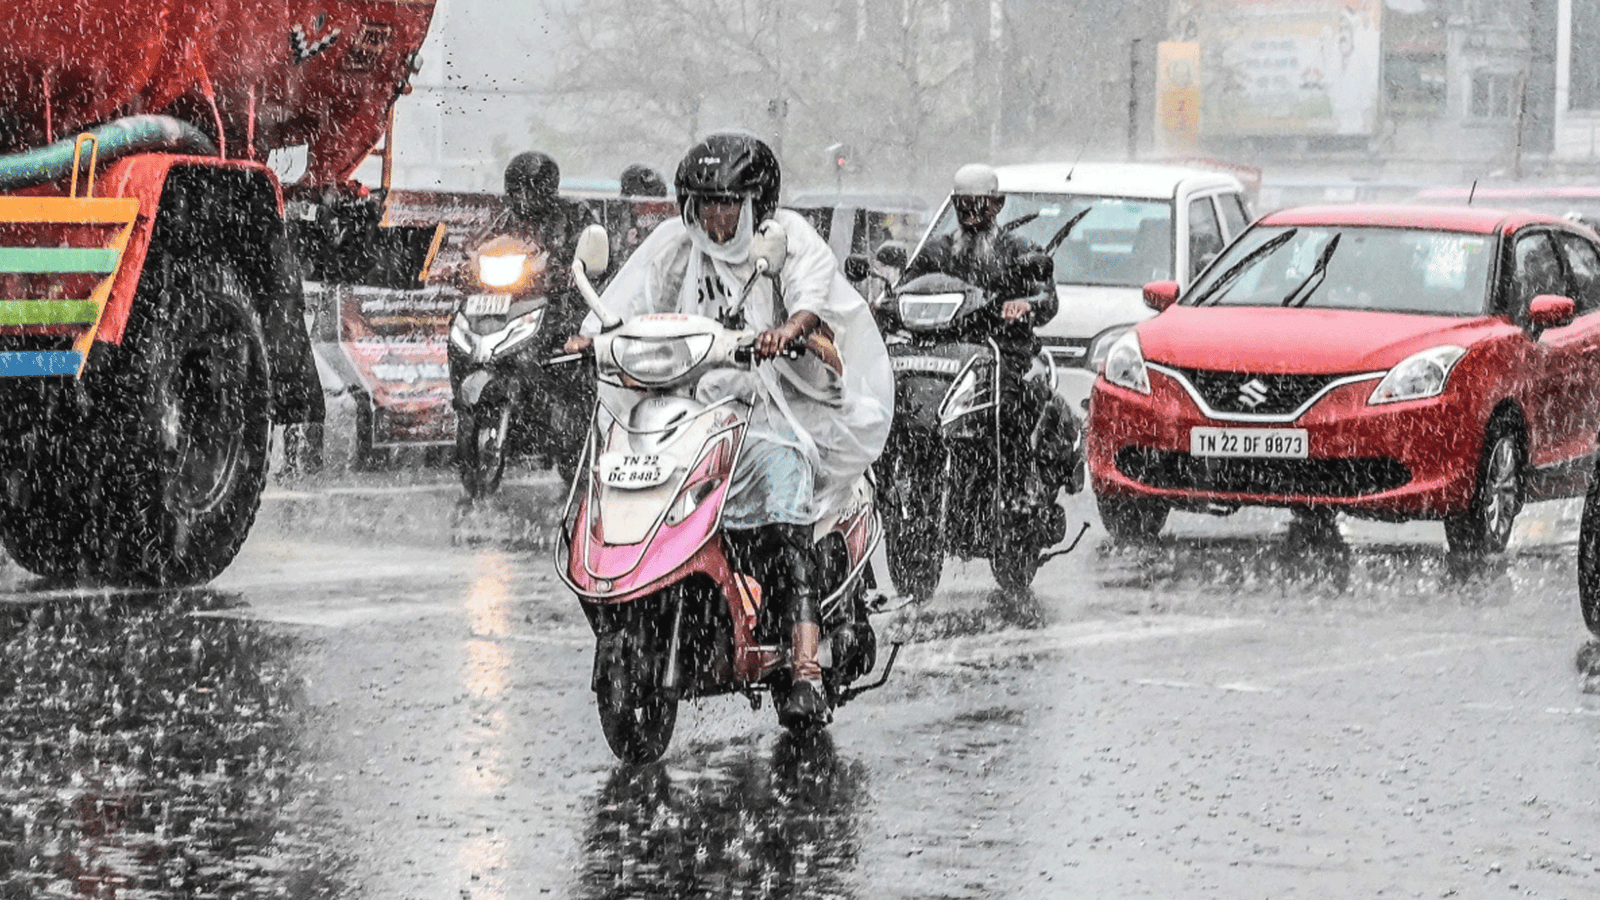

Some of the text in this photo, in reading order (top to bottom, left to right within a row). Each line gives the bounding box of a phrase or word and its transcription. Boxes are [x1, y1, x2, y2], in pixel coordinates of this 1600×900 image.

[1199, 434, 1216, 452] TN
[1221, 434, 1238, 453] 22
[1243, 436, 1261, 453] DF
[623, 455, 659, 466] TN 22
[608, 471, 661, 482] DC 8482
